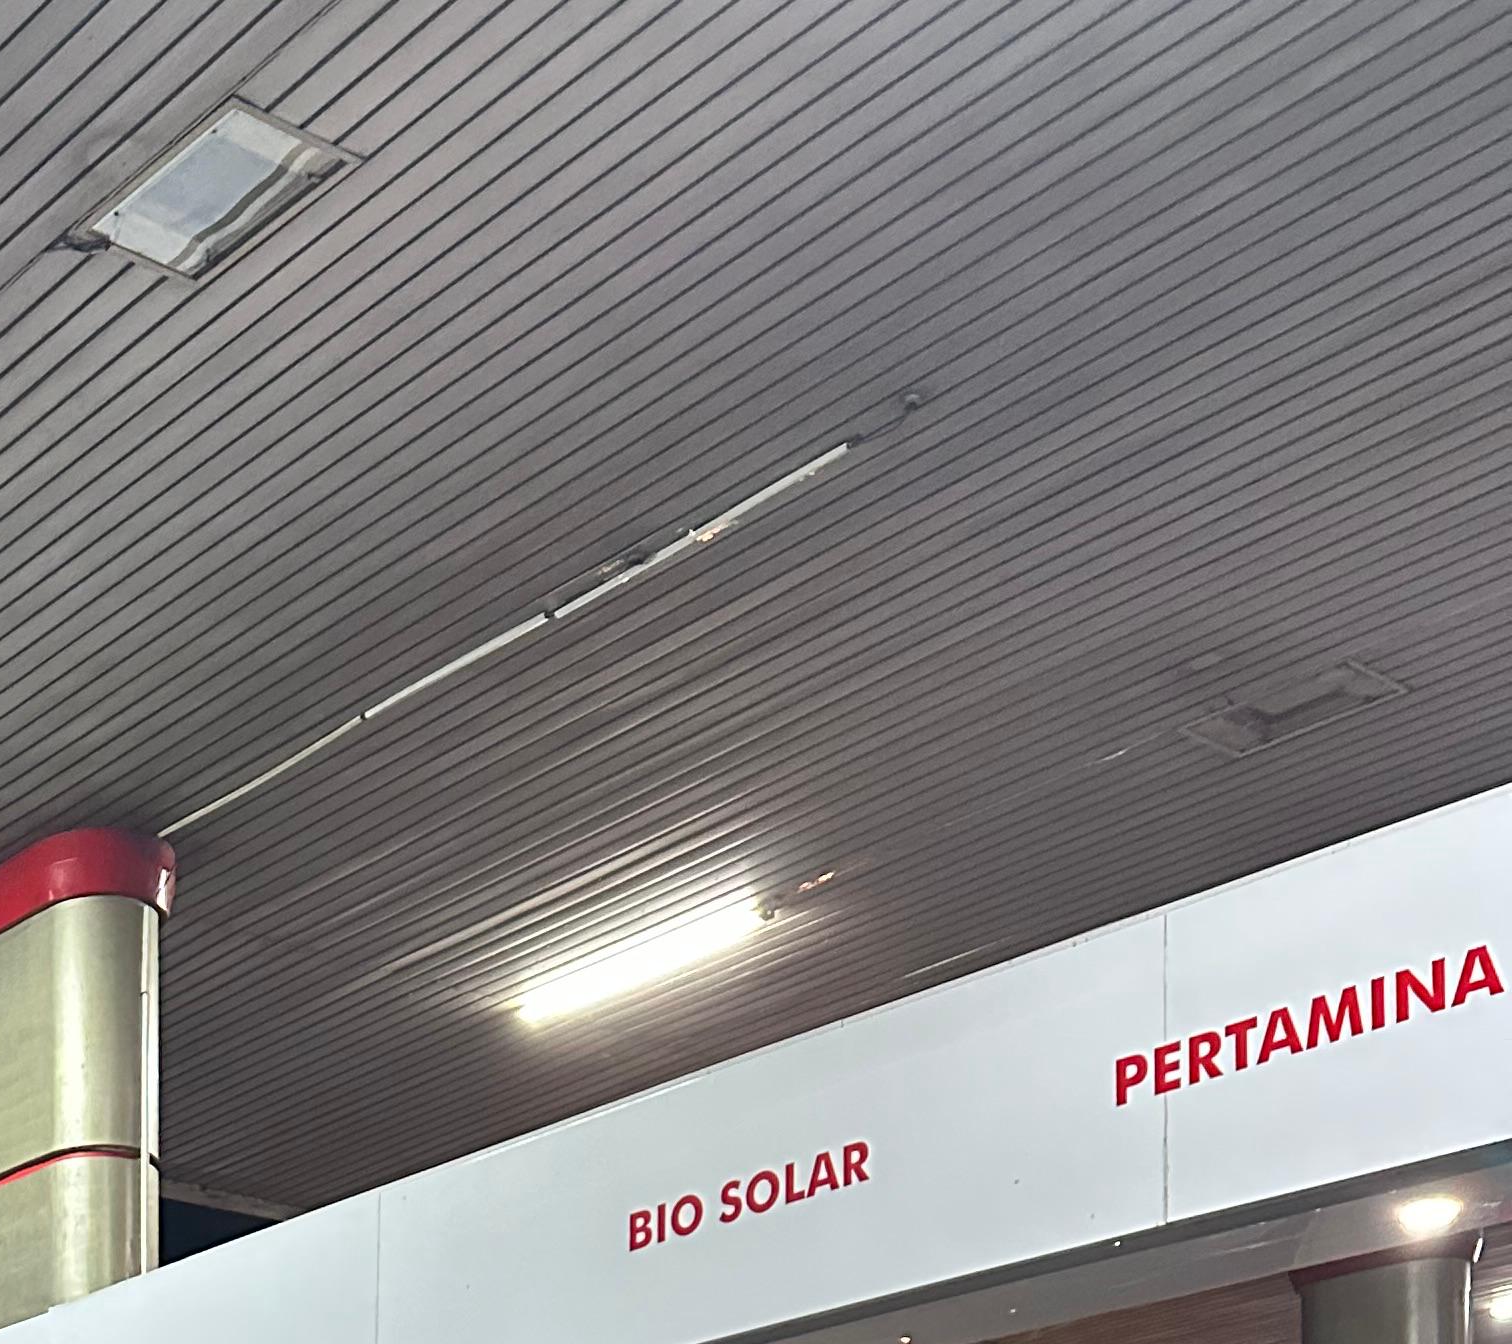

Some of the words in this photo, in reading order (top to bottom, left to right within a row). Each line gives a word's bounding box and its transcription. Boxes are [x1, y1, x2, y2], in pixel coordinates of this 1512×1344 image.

[1115, 944, 1505, 1107] PERTAMINA
[628, 1193, 703, 1251] BIO
[719, 1140, 870, 1223] SOLAR
